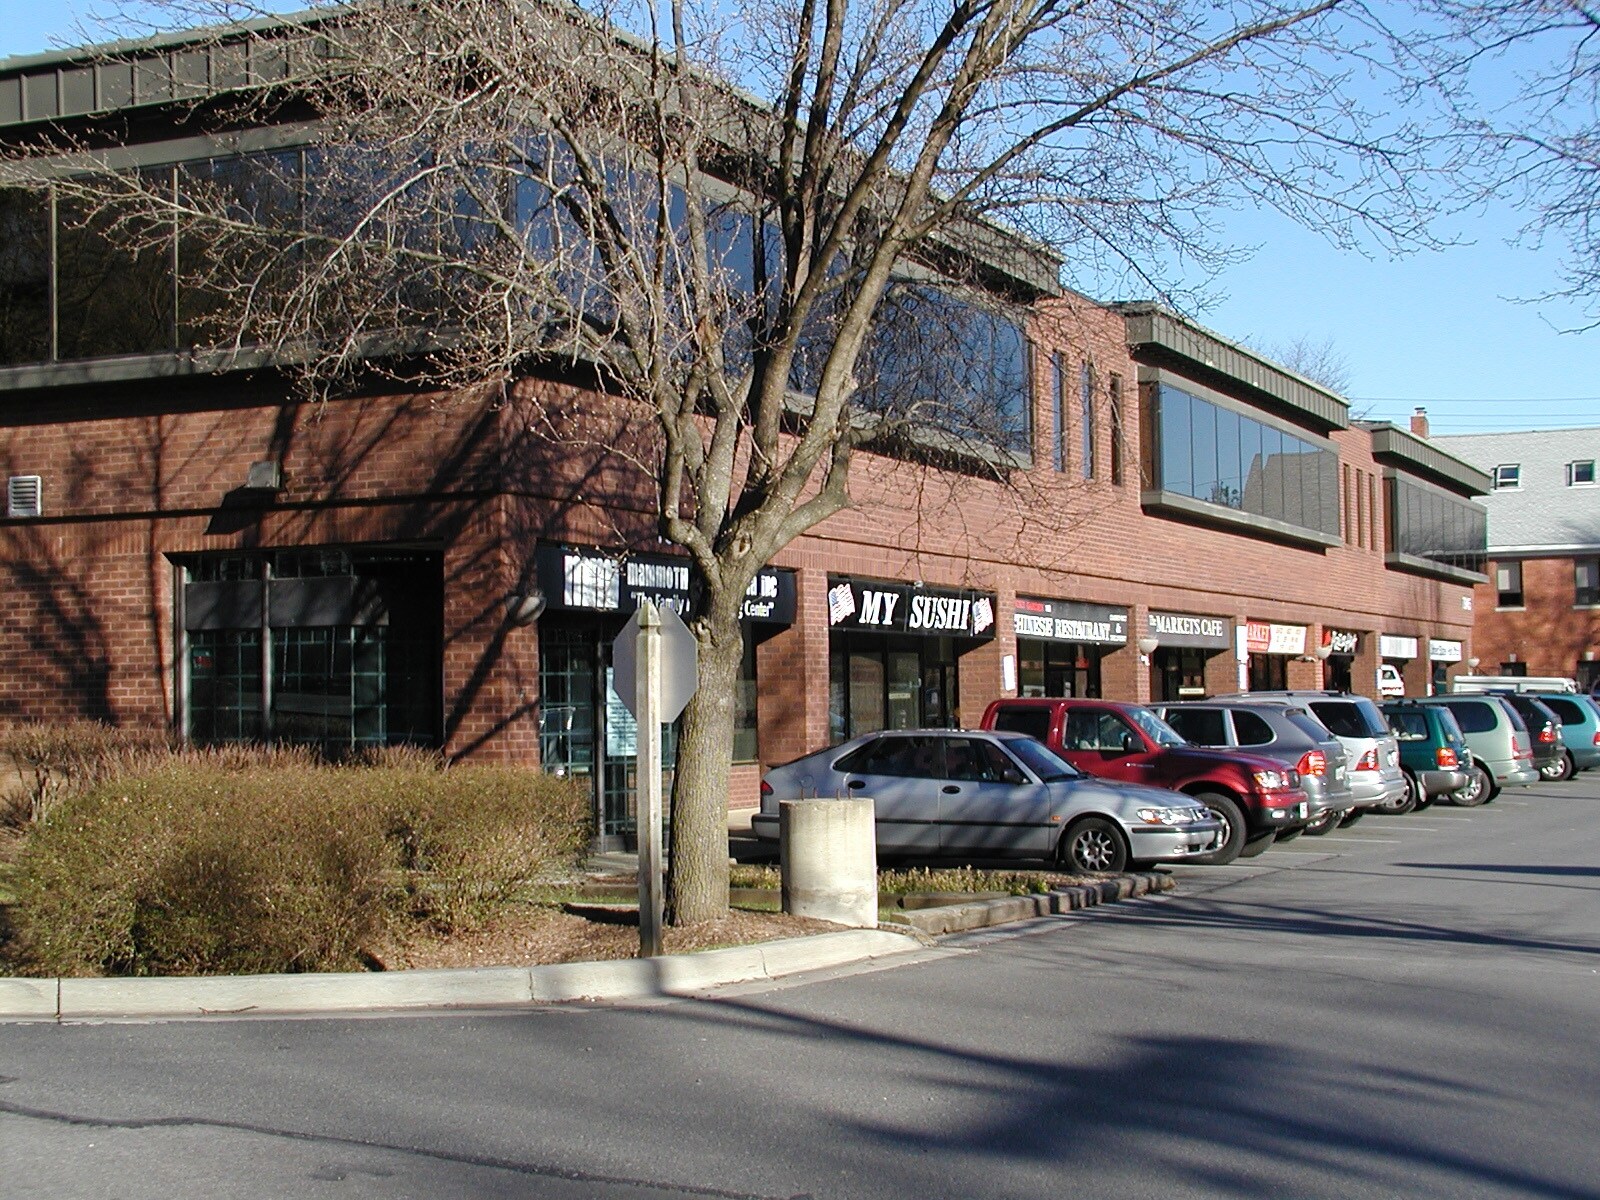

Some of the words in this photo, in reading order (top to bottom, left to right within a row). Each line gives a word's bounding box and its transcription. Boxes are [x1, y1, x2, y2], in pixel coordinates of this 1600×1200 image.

[859, 590, 900, 626] MY
[909, 595, 971, 630] SUSHI
[1054, 619, 1111, 641] RESTAURANT
[1201, 619, 1223, 637] CAFE
